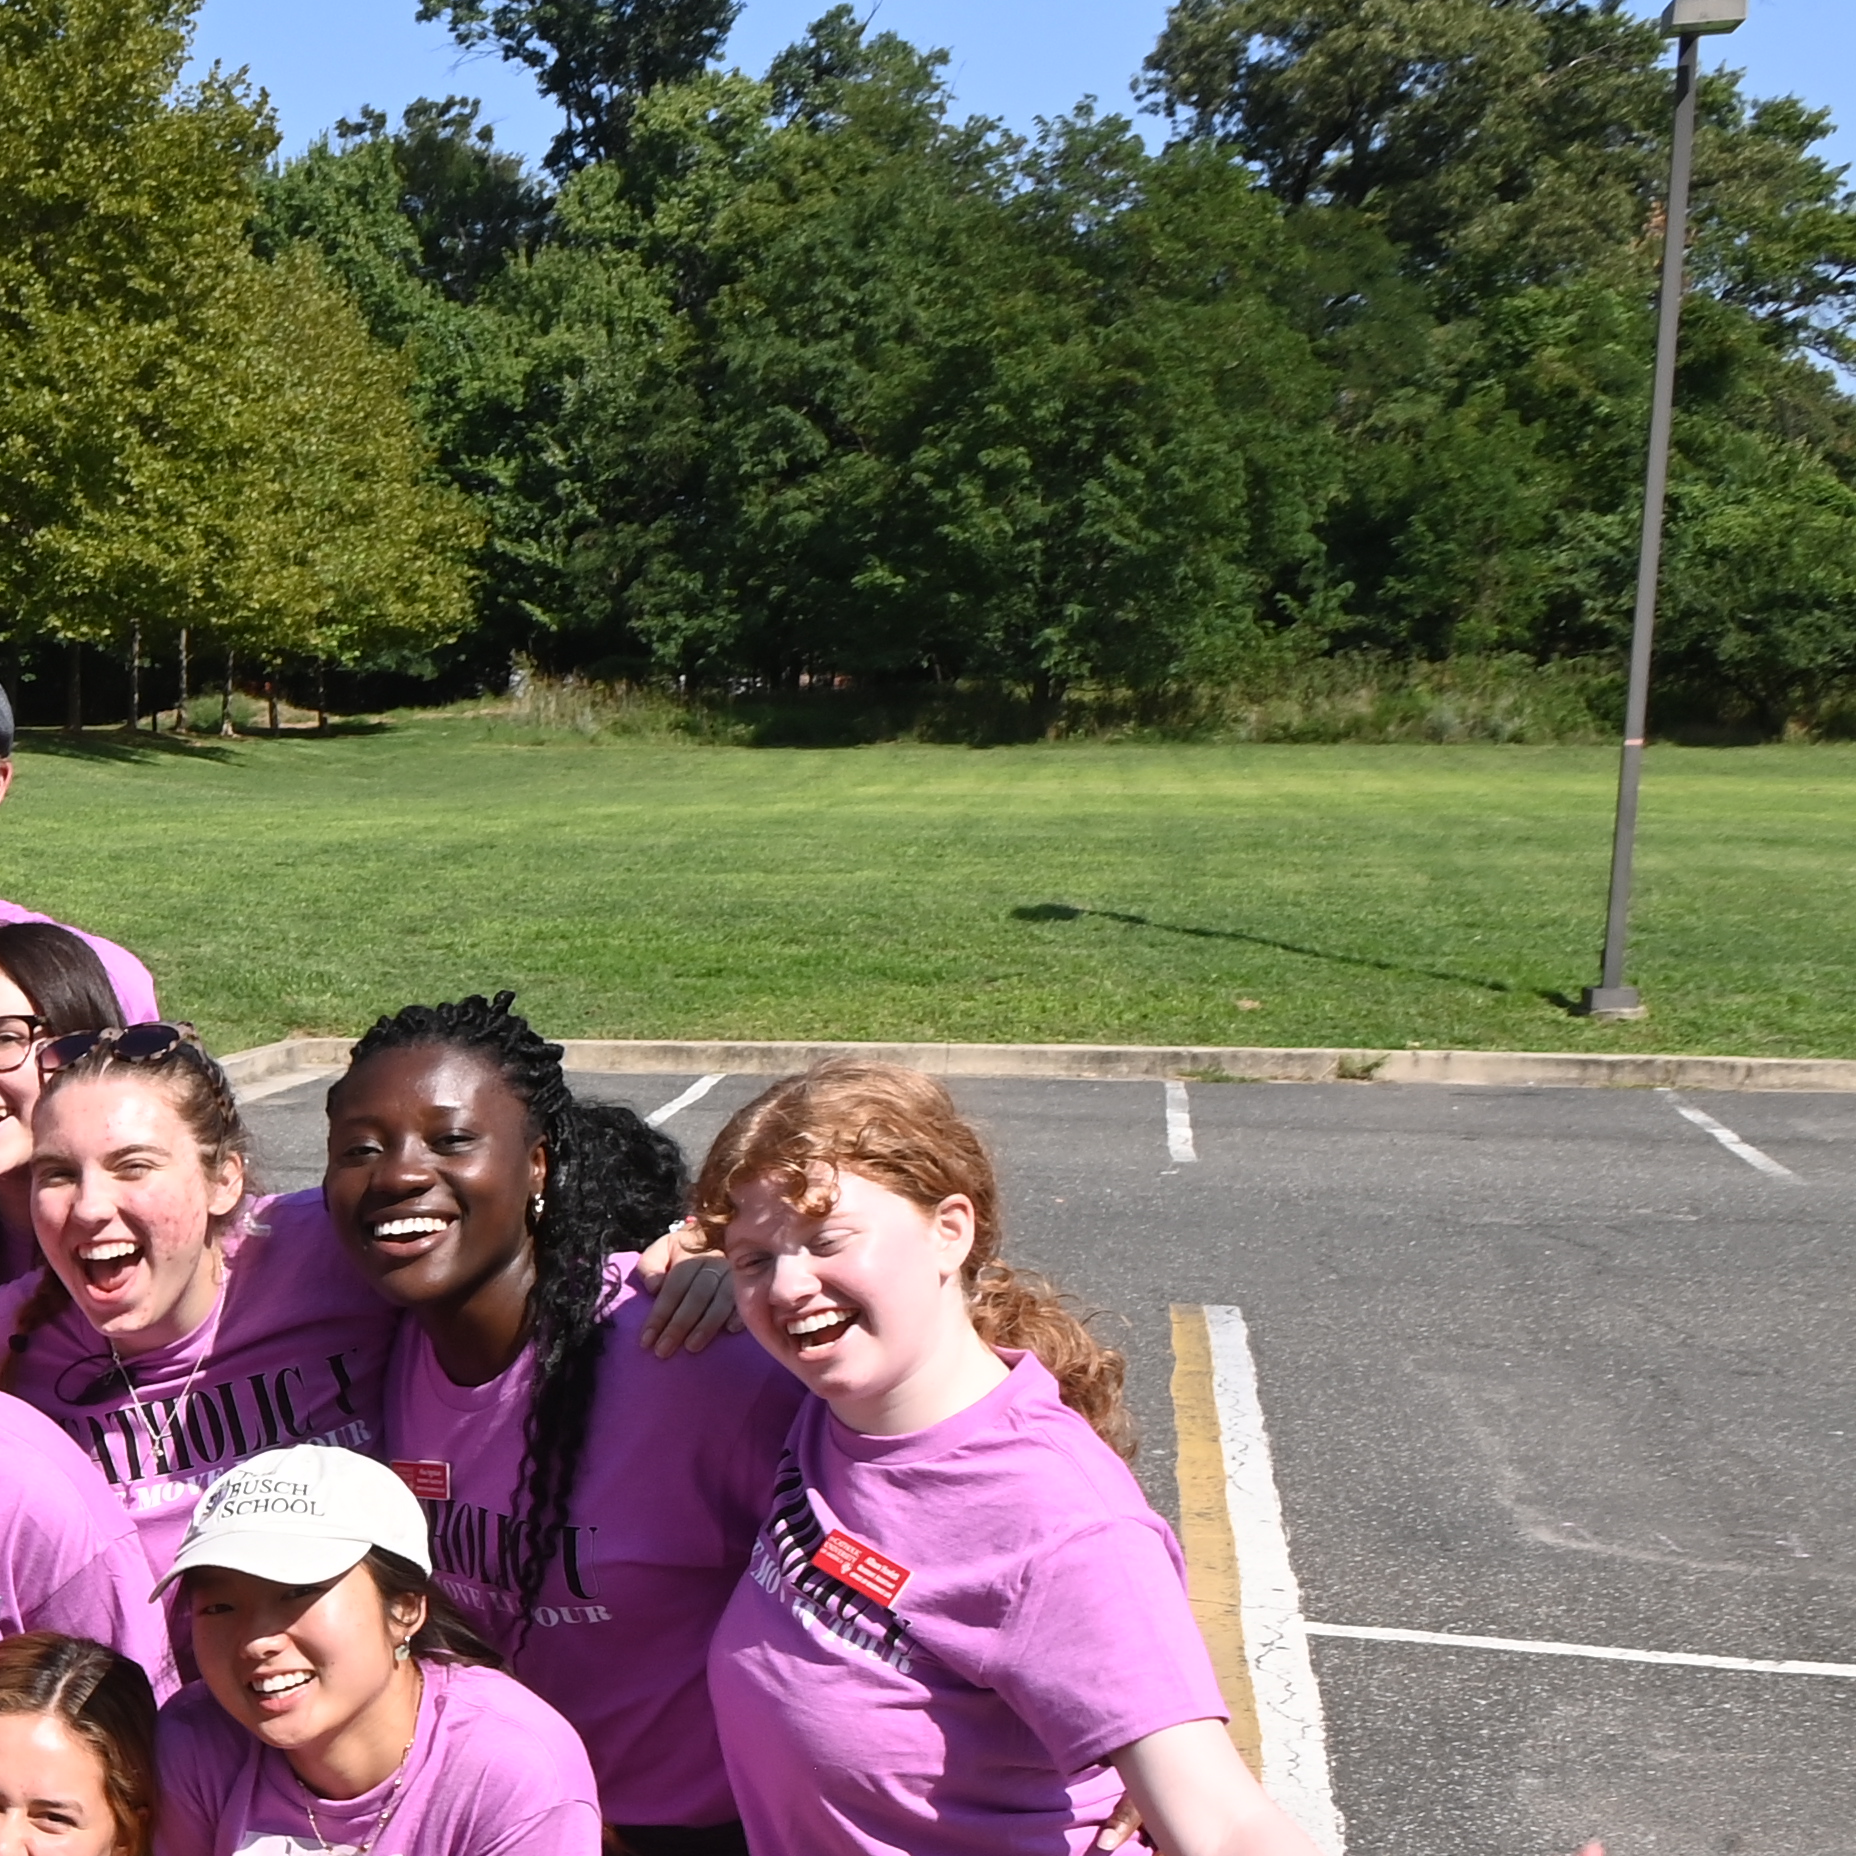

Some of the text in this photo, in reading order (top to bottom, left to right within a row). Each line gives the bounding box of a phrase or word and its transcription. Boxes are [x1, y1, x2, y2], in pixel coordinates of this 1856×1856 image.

[229, 1479, 308, 1500] BUSCH
[220, 1498, 326, 1519] SCHOOL
[561, 1526, 600, 1600] U
